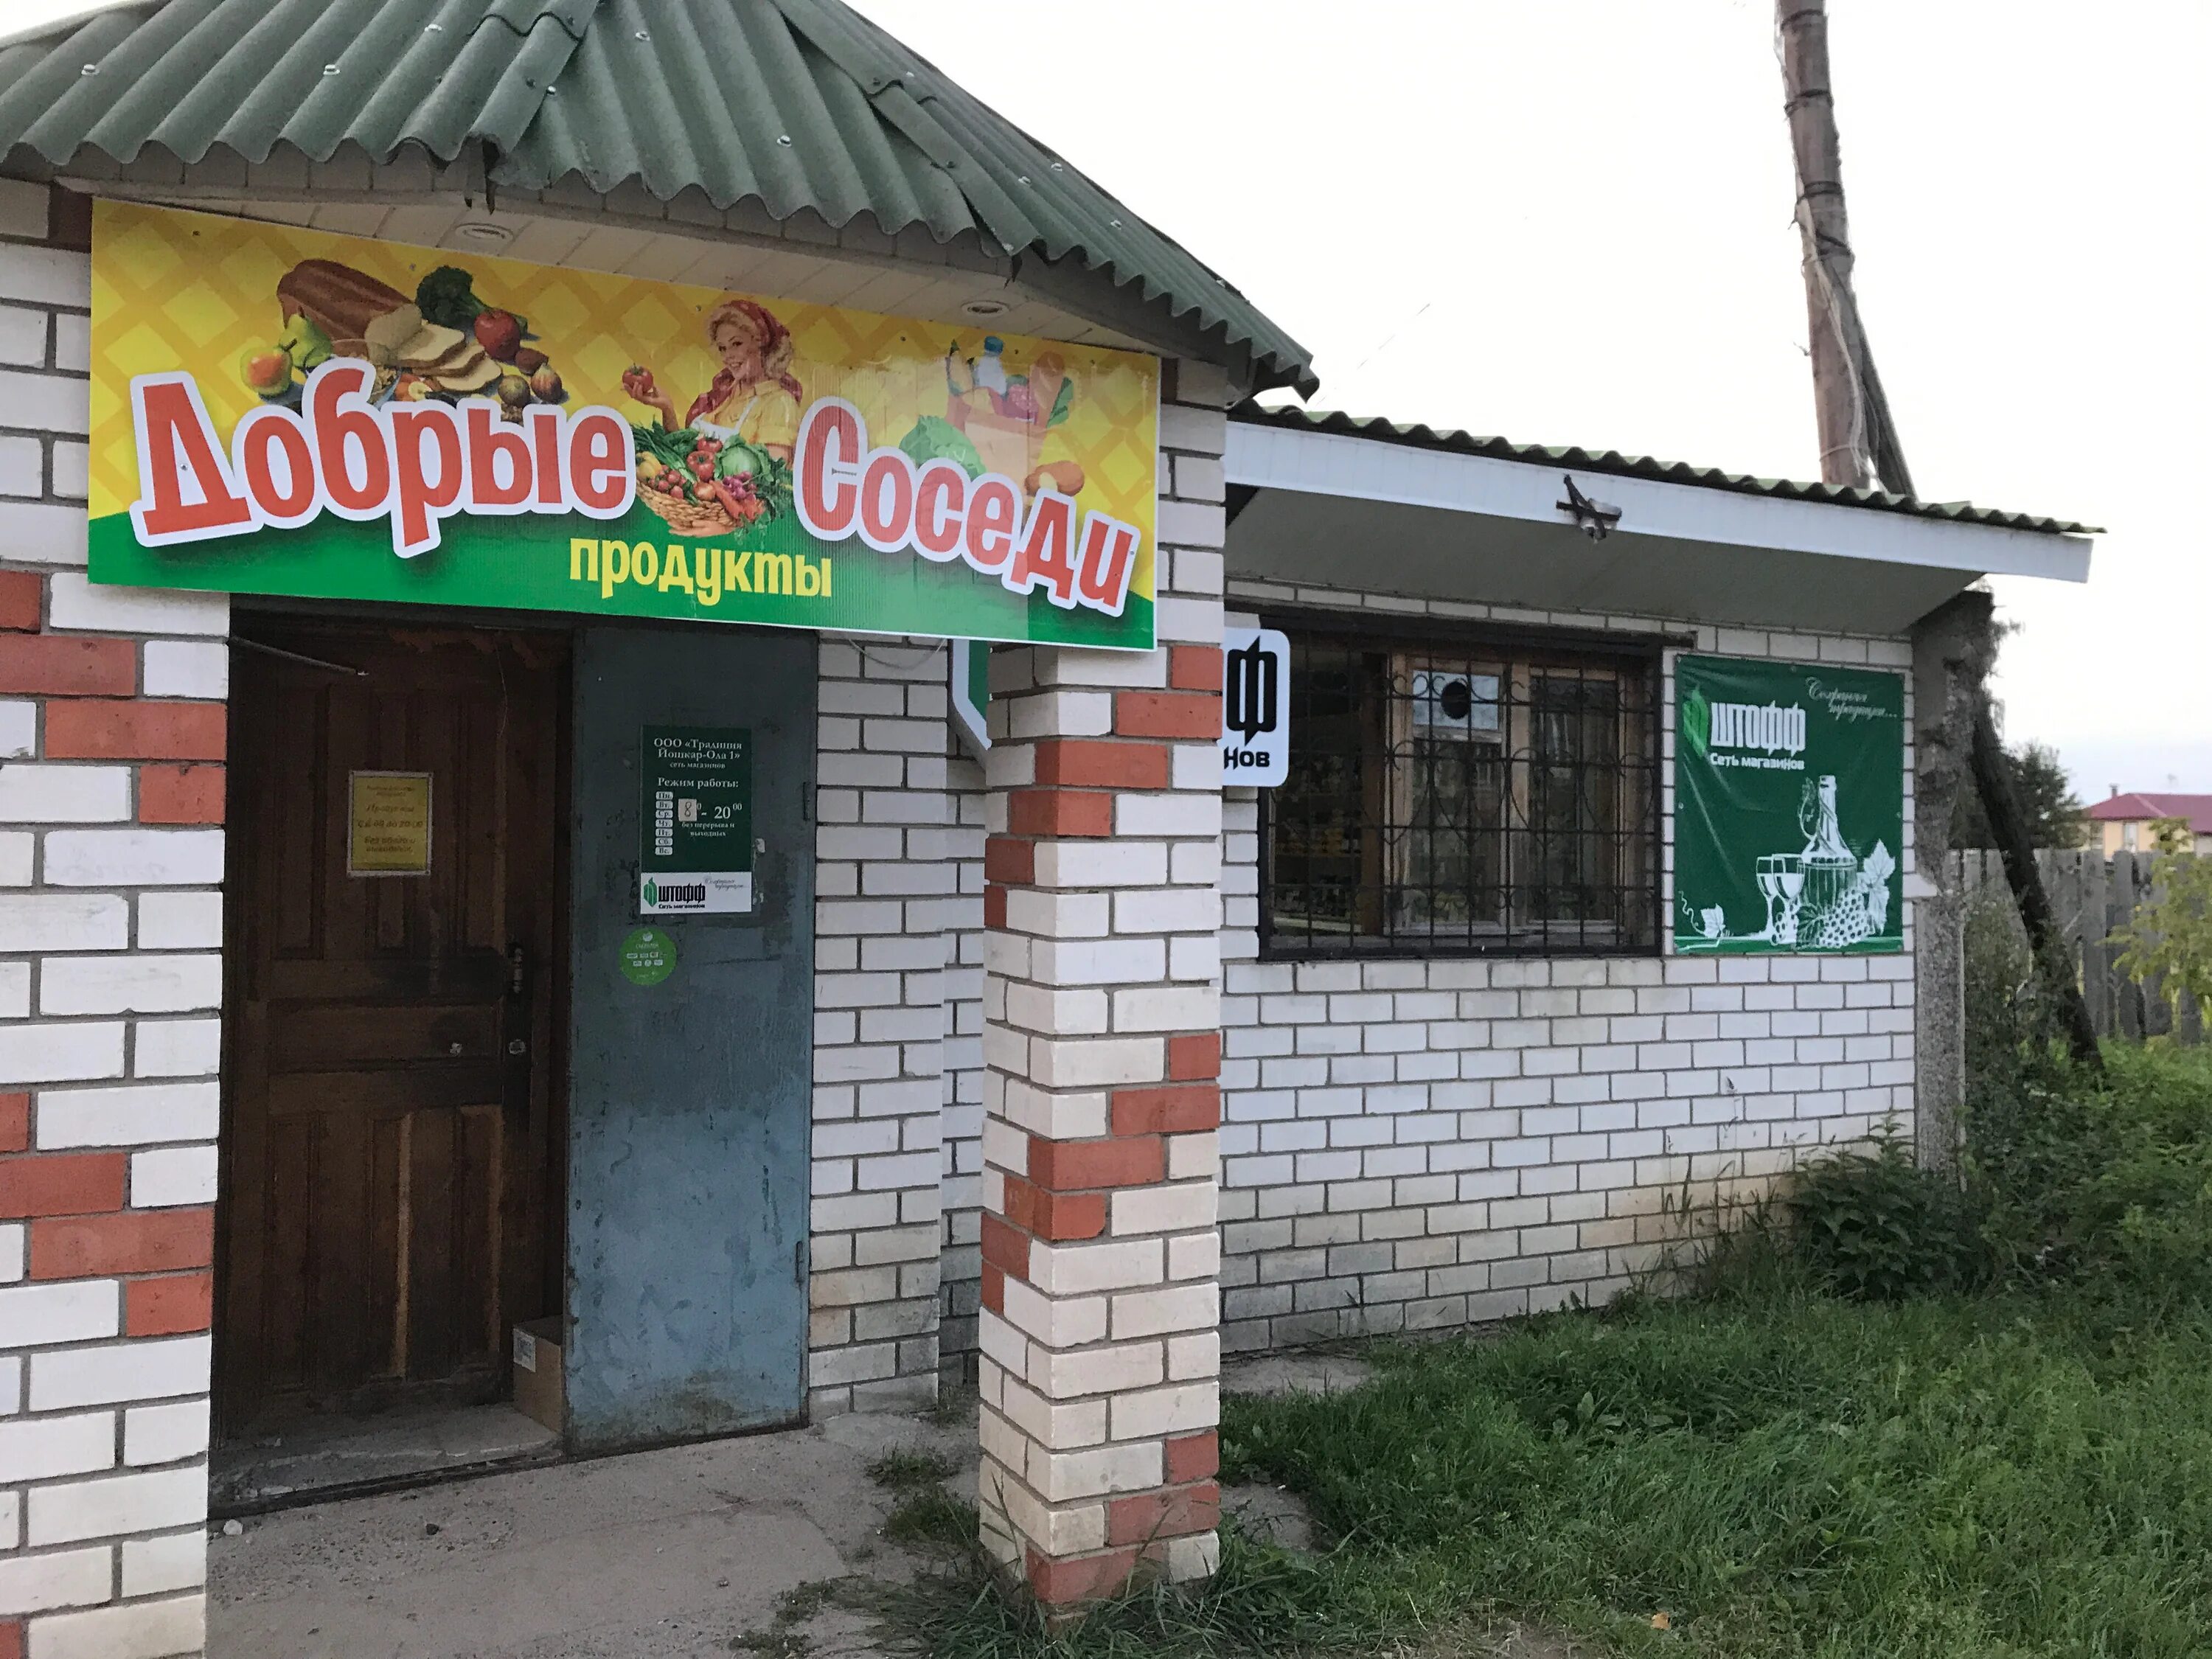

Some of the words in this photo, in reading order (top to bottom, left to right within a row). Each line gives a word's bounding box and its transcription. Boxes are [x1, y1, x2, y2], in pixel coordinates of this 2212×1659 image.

[139, 364, 630, 552] Добрые
[810, 403, 1138, 611] Соседи
[568, 537, 832, 607] продукты
[653, 738, 682, 748] ООО
[658, 747, 727, 762] Йошкар-Ола
[1709, 751, 1739, 769] Сеть
[658, 776, 695, 787] Режим
[697, 779, 740, 790] работы:
[684, 801, 692, 818] 8
